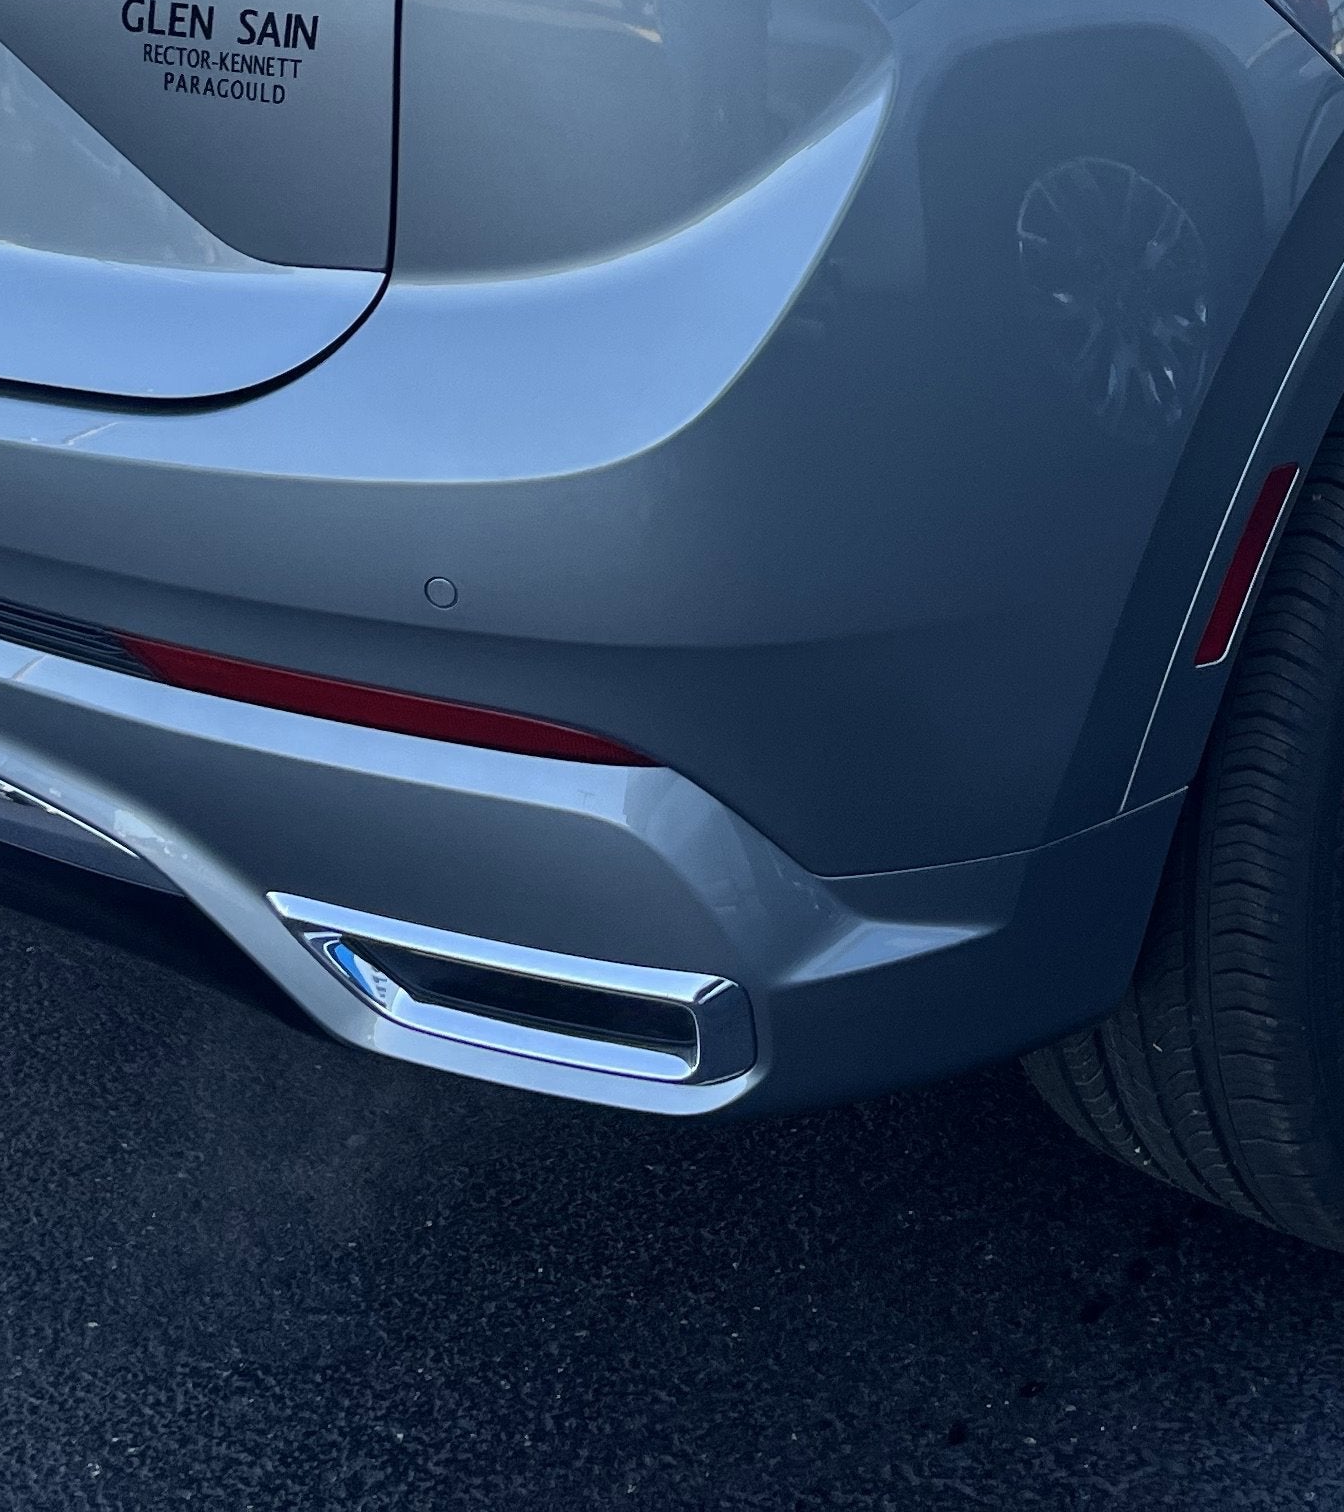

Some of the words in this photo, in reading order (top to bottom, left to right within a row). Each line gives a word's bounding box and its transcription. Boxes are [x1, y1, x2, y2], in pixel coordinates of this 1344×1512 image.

[236, 9, 319, 50] SAIN
[143, 43, 303, 79] RECTOR-KENNETT
[163, 72, 286, 105] PARAGOULD
